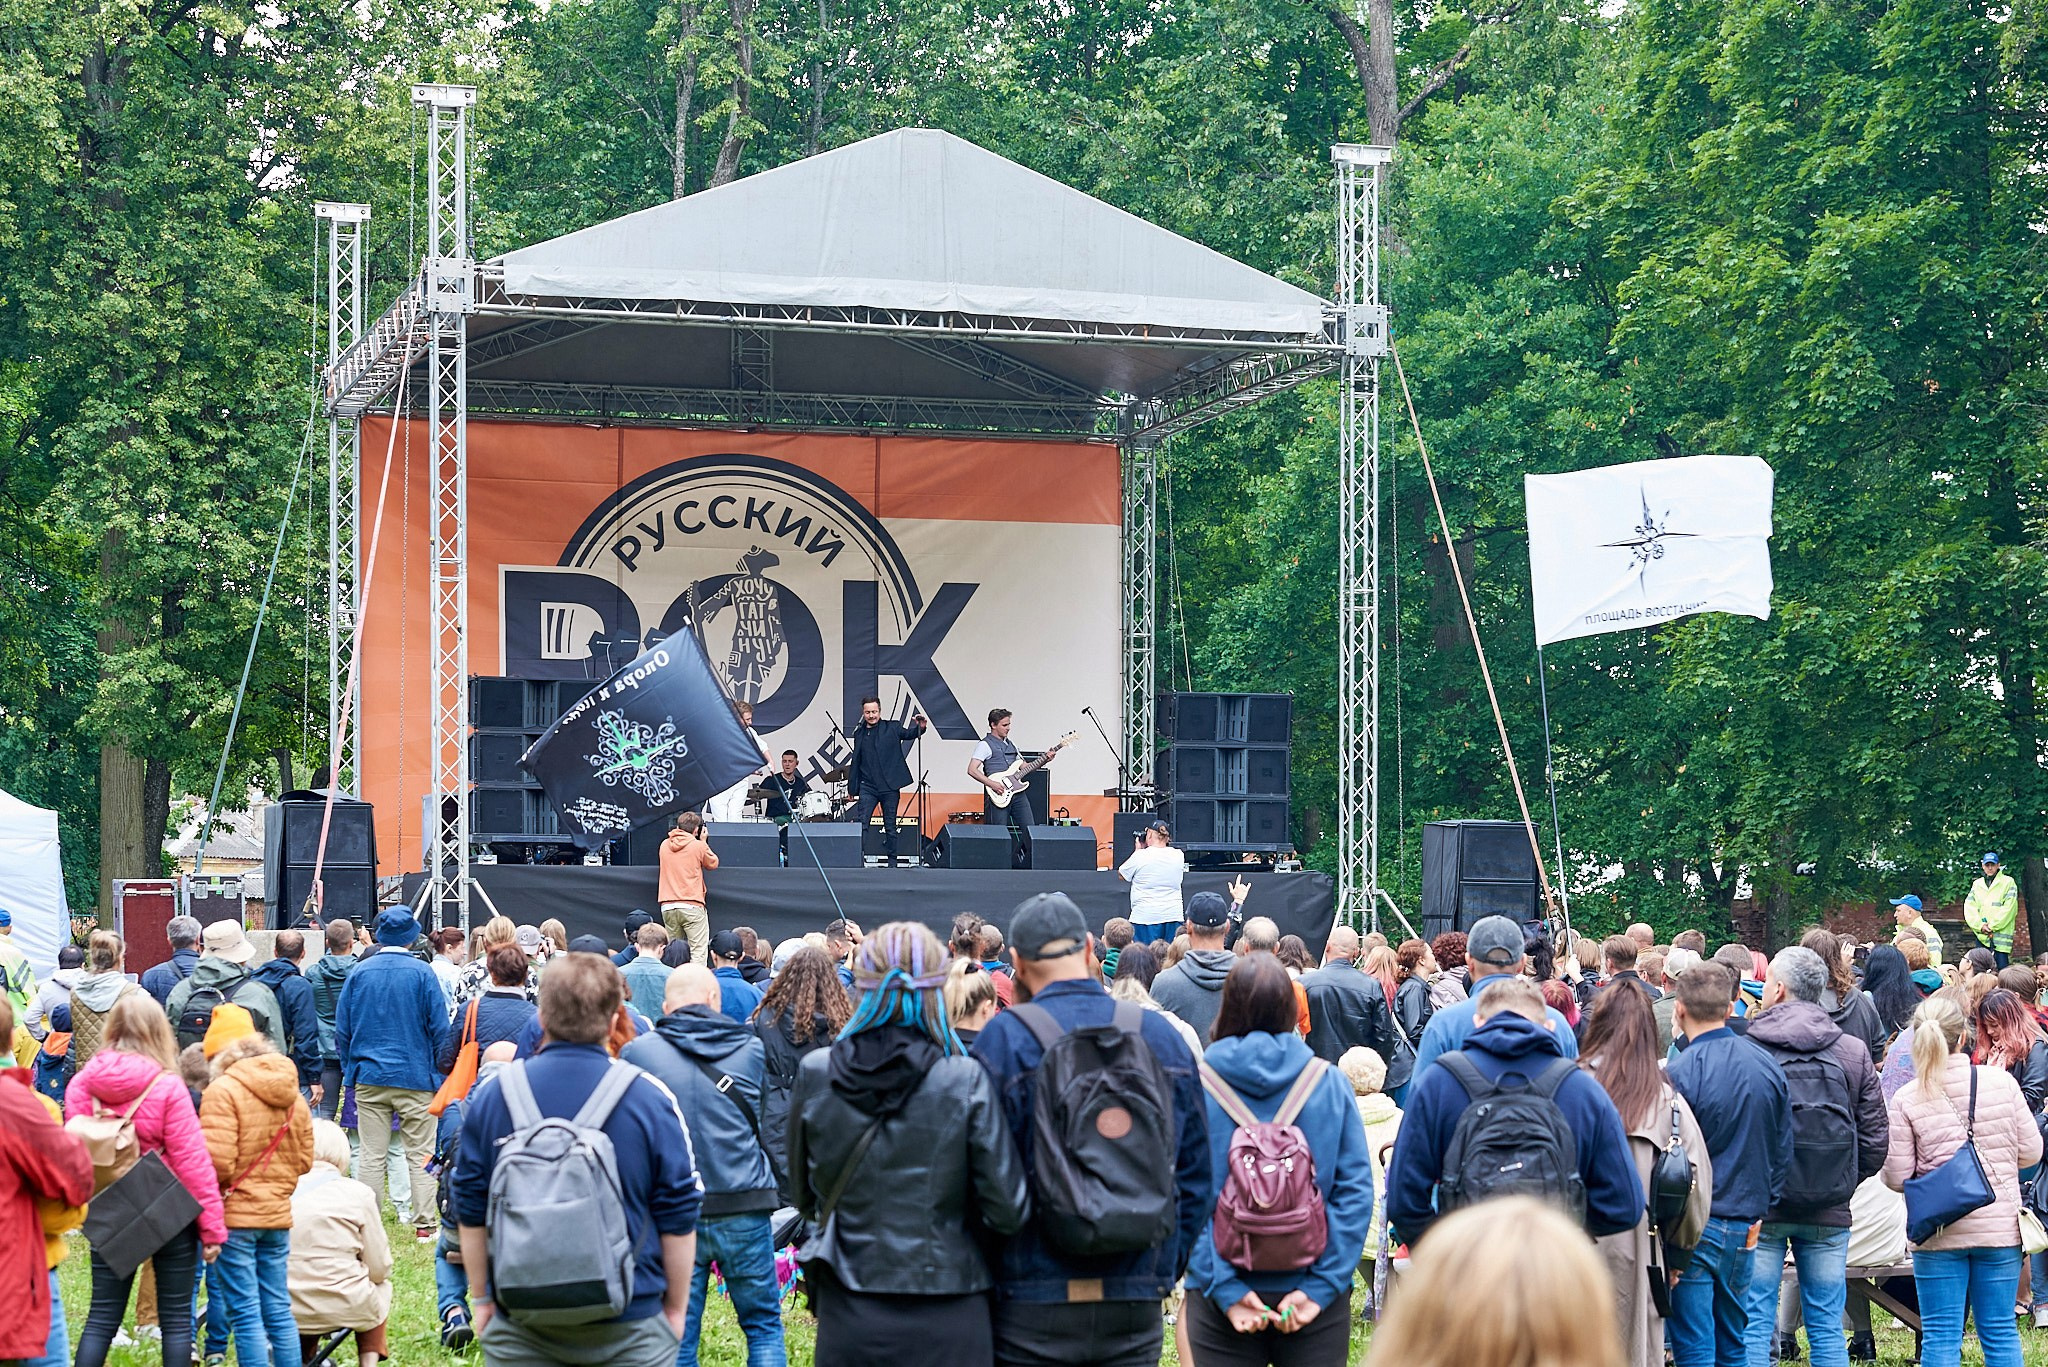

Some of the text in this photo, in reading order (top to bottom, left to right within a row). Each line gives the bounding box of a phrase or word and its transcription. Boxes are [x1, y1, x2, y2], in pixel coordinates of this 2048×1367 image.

[610, 495, 846, 573] РУССКИЙ
[733, 577, 774, 602] ХОЧУ
[739, 601, 767, 620] ГАТ
[1584, 608, 1642, 625] ПЛОЩАДЬ
[740, 620, 766, 637] ЧИ
[505, 570, 980, 741] РОК
[738, 637, 773, 663] НУ!
